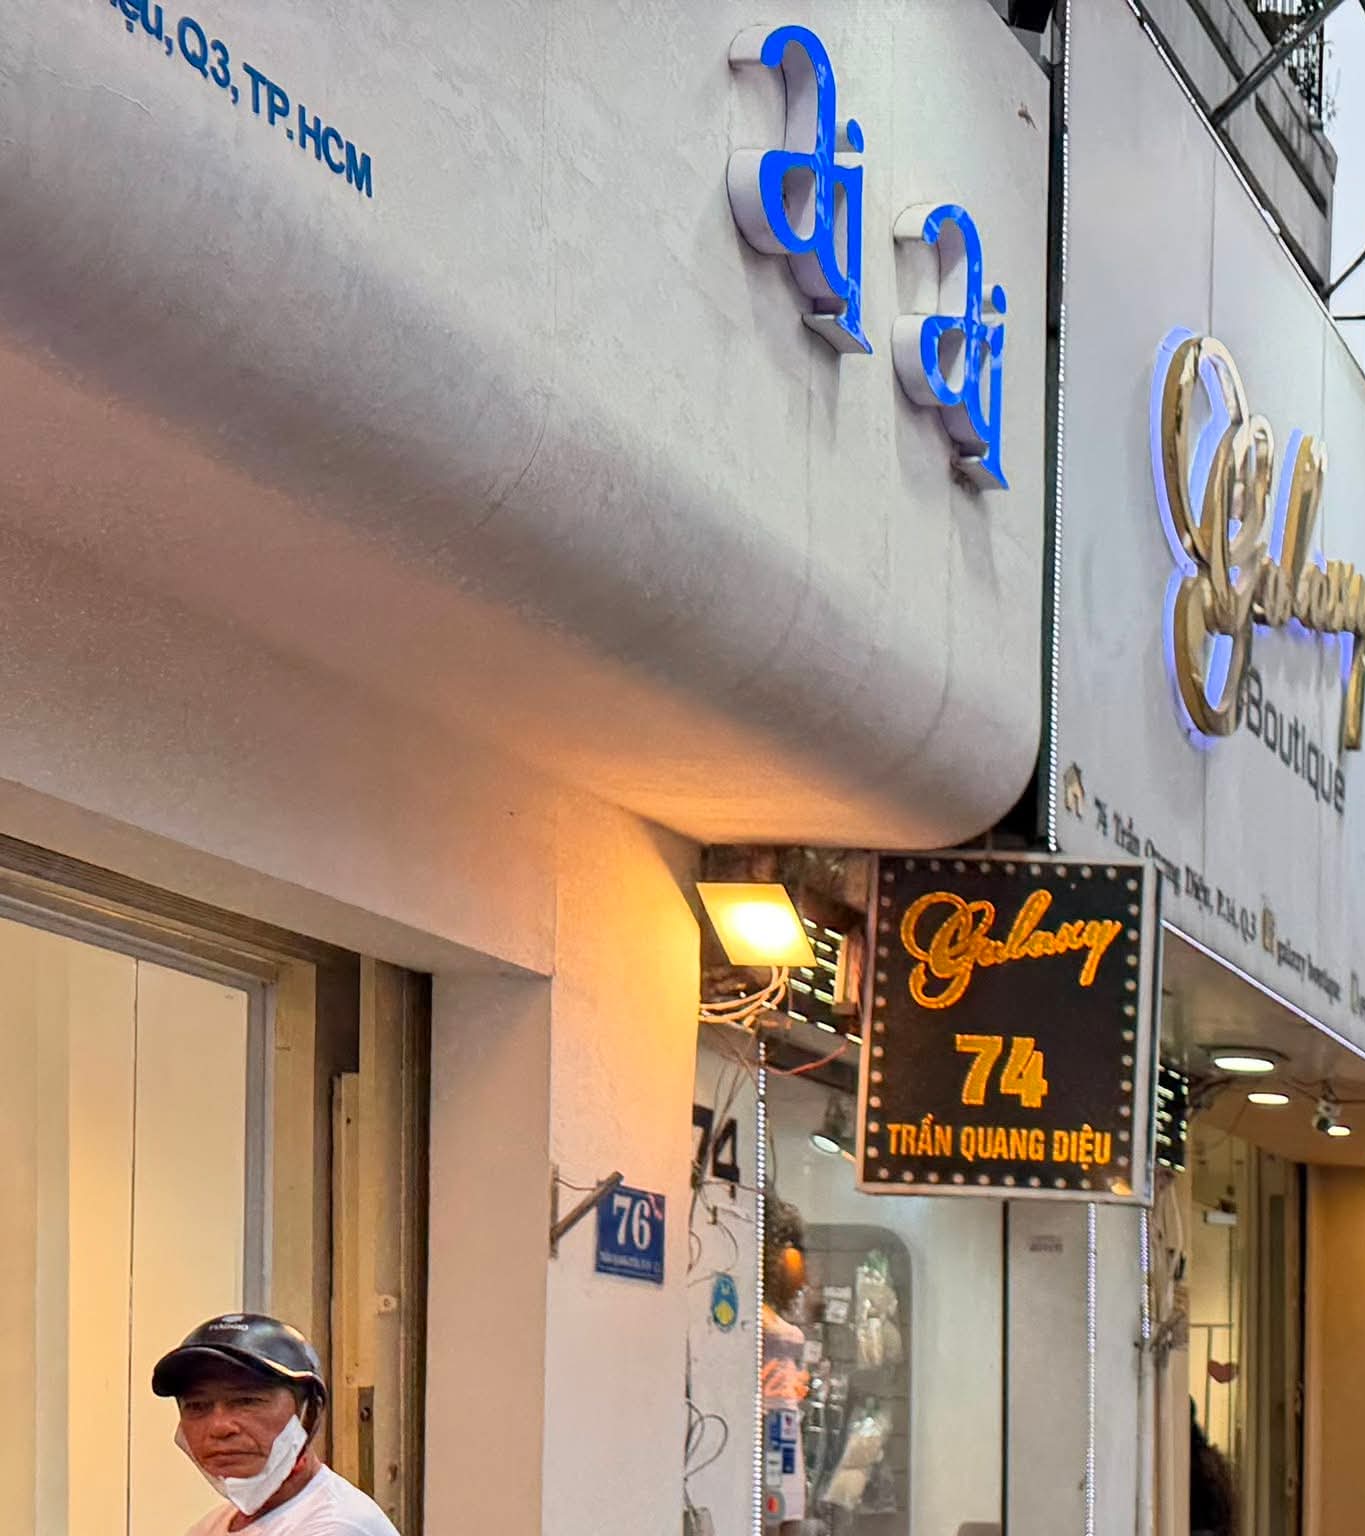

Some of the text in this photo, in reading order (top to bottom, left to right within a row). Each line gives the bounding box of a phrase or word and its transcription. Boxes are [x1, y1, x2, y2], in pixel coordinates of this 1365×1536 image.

[242, 62, 373, 197] TP.HCM
[1246, 666, 1345, 816] Boutique
[900, 888, 1123, 1009] Galaxy
[955, 1033, 1049, 1109] 74
[886, 1112, 1112, 1171] TRẦN QUANG DIỆU
[613, 1193, 652, 1250] 76
